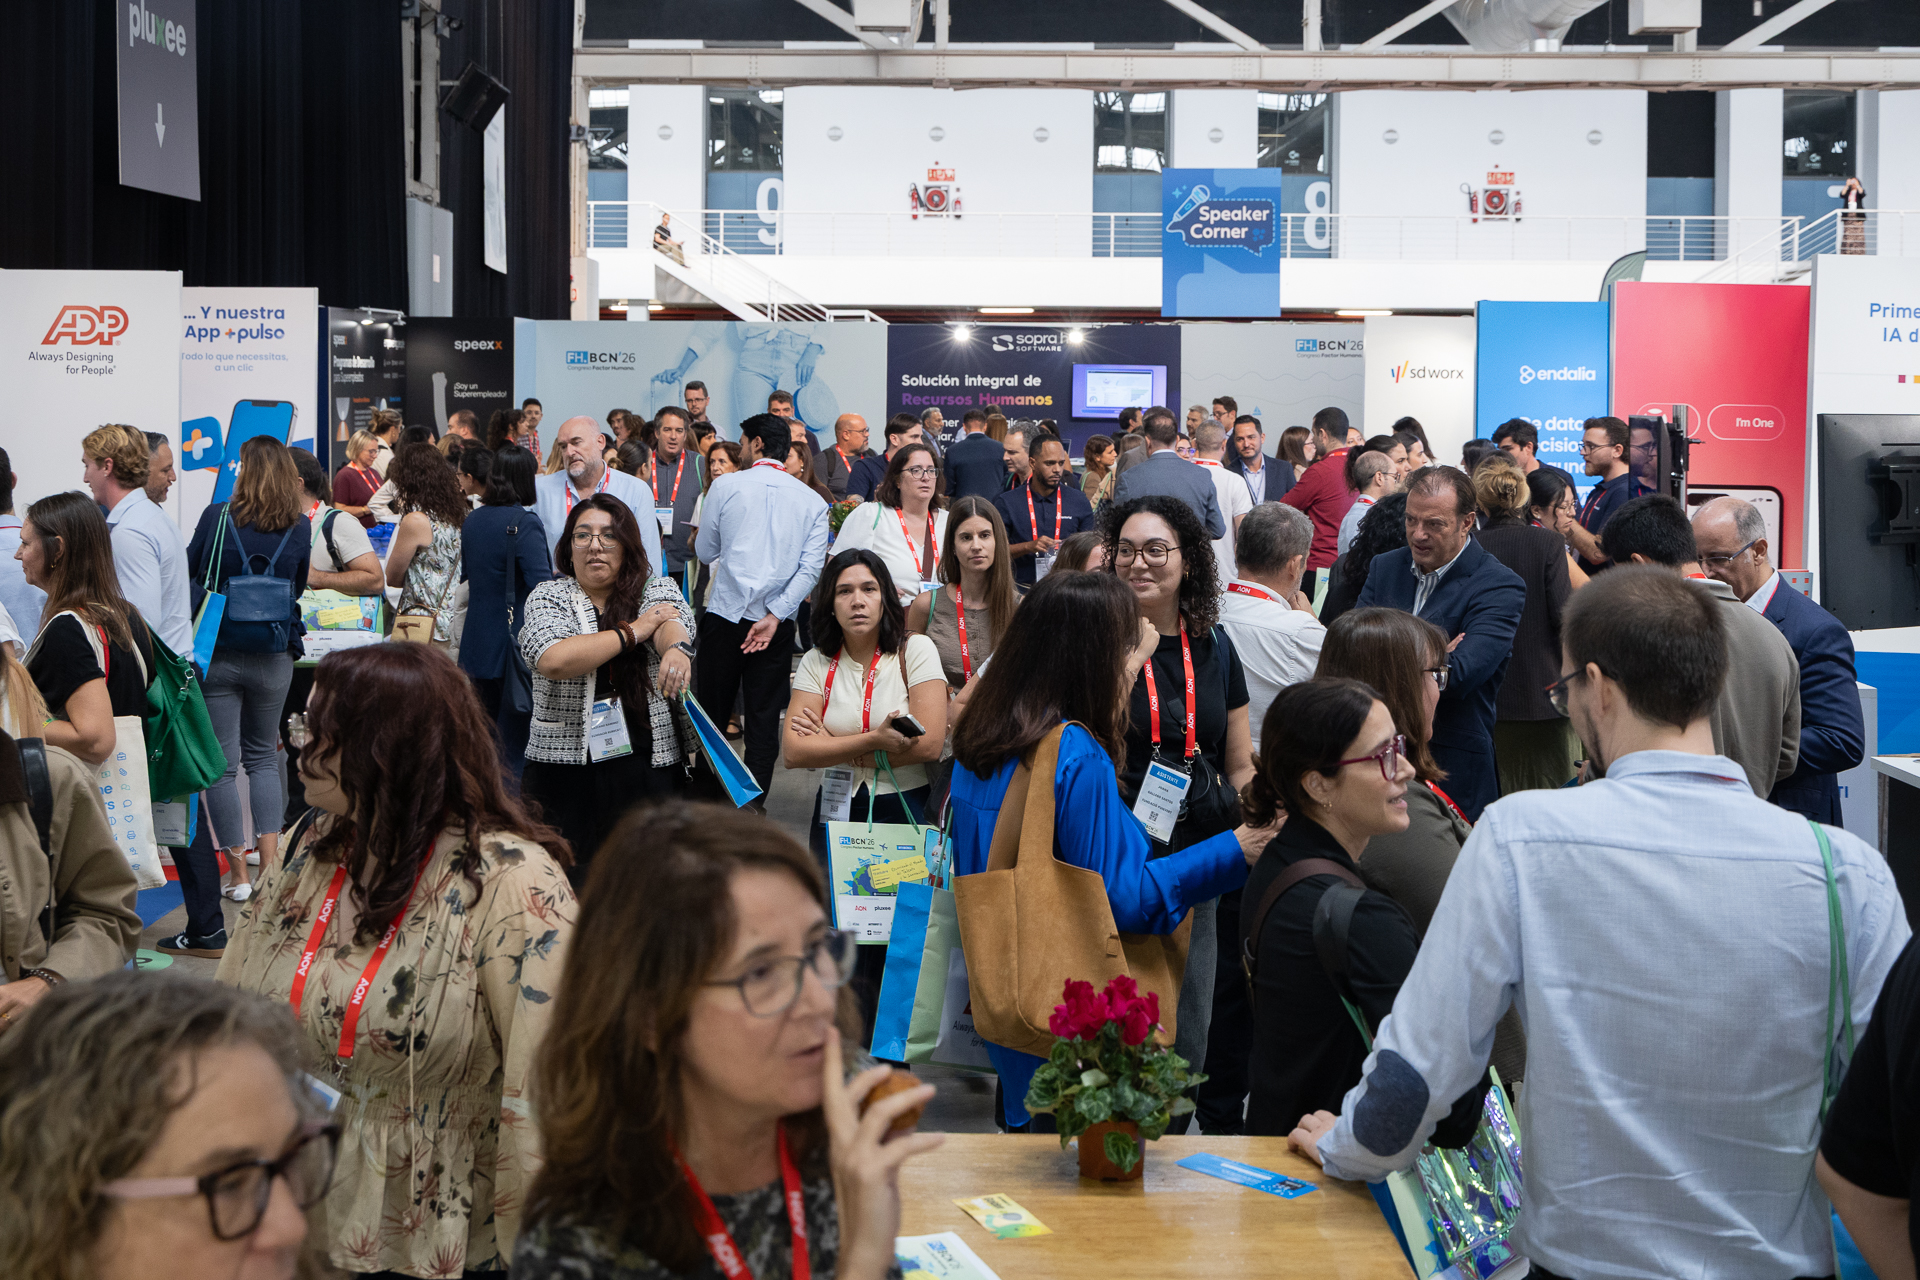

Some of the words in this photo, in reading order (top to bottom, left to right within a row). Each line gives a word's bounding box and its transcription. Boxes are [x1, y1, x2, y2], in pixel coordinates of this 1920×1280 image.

[129, 0, 186, 56] pluxee
[756, 178, 783, 246] 9
[1199, 206, 1270, 224] Speaker
[1304, 181, 1330, 250] 8
[1190, 224, 1248, 239] Corner
[201, 306, 211, 319] Y
[216, 307, 285, 319] nuestra
[41, 305, 129, 345] ADP
[185, 325, 220, 342] App
[1016, 335, 1057, 345] sopra
[1884, 328, 1902, 342] IA
[454, 340, 502, 352] speexx
[28, 352, 64, 362] Always
[66, 352, 113, 363] Designing
[206, 352, 214, 360] lo
[216, 354, 234, 362] que
[236, 353, 288, 361] necessitas,
[66, 365, 79, 374] for
[82, 365, 114, 376] People
[1537, 366, 1596, 381] endalia
[901, 374, 959, 386] Solución
[965, 374, 1018, 389] integral
[1023, 375, 1041, 386] de
[454, 391, 507, 399] Superempleado!
[902, 393, 972, 405] Recursos
[979, 393, 1053, 405] Humanos
[1736, 418, 1750, 427] I'm
[1752, 418, 1774, 428] One
[318, 898, 334, 922] AON
[379, 924, 396, 948] AON
[297, 952, 313, 976] AON
[352, 977, 370, 1004] AON
